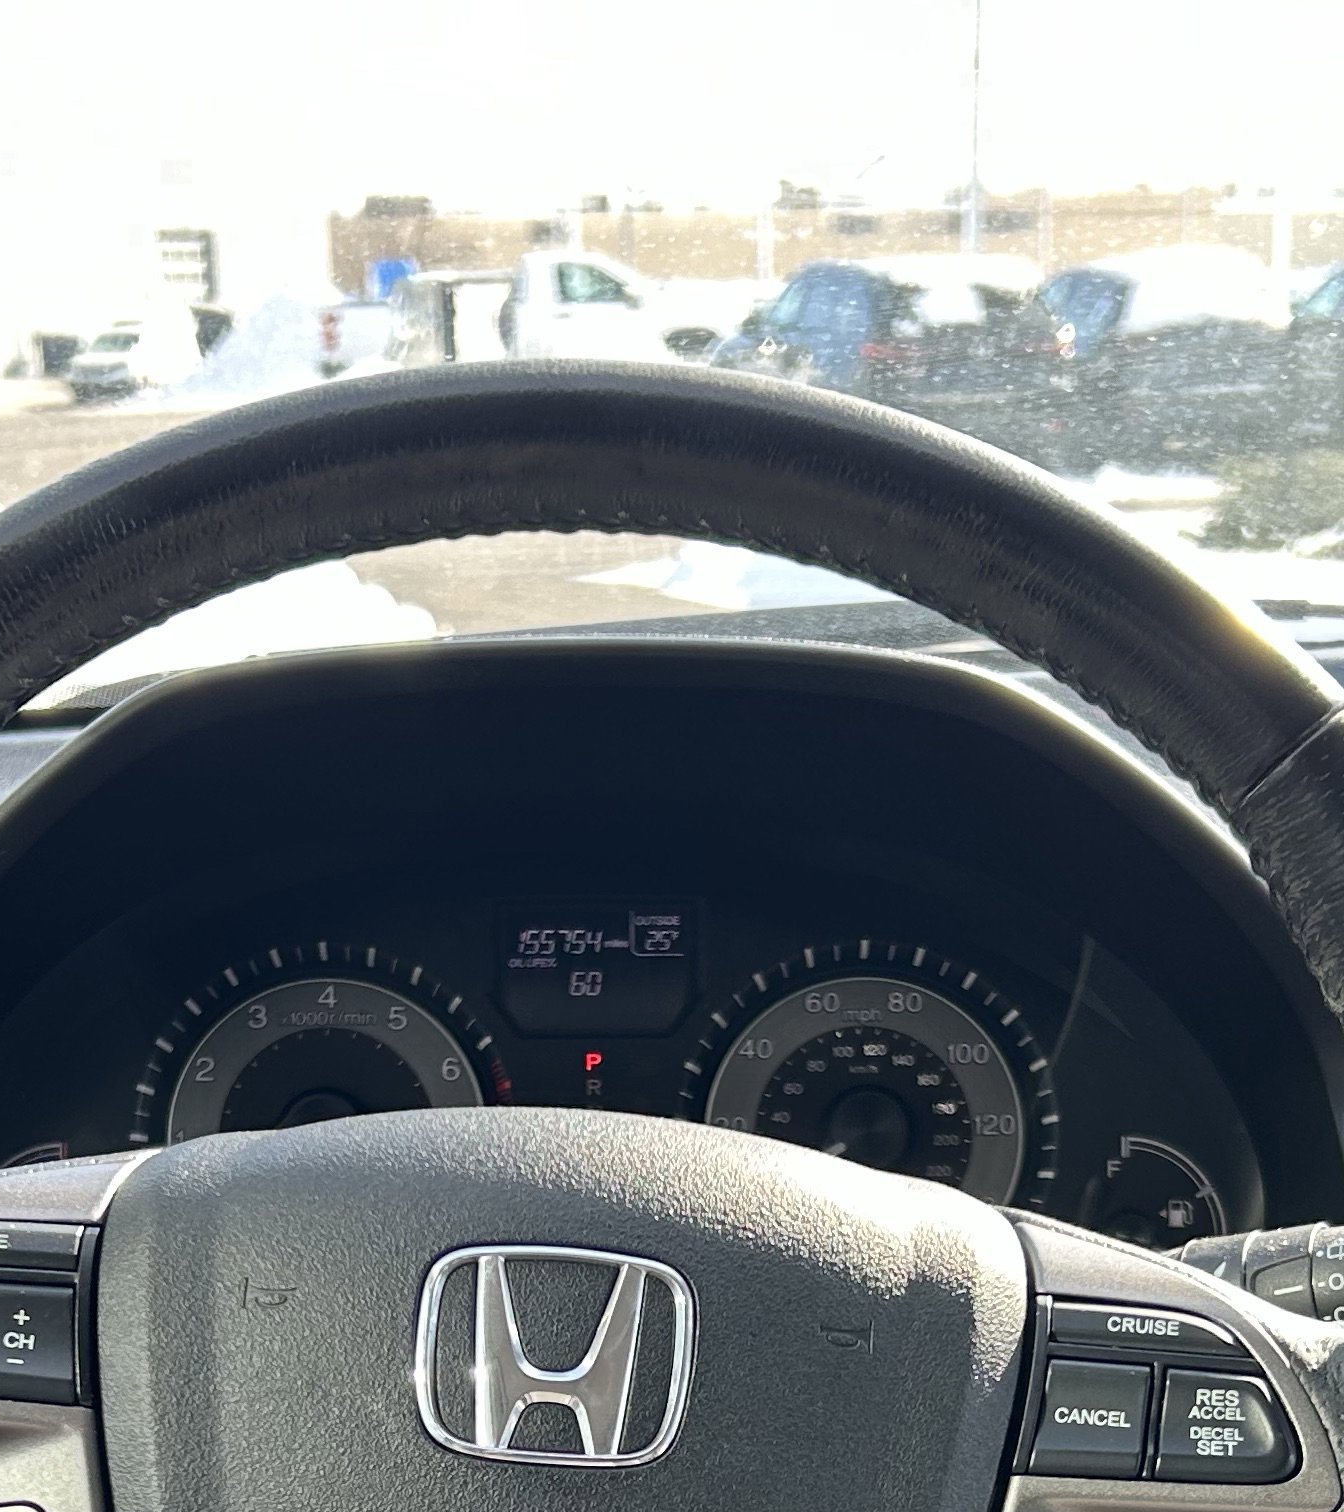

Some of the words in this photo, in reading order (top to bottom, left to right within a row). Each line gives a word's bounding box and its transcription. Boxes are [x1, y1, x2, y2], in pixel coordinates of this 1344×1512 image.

[317, 984, 338, 1009] 4
[805, 992, 840, 1013] 60
[888, 992, 923, 1013] 80
[247, 1005, 268, 1029] 3
[387, 1006, 408, 1031] 5
[738, 1038, 774, 1060] 40
[947, 1043, 990, 1065] 100
[194, 1057, 216, 1082] 2
[441, 1057, 462, 1082] 6
[585, 1051, 603, 1072] P
[585, 1079, 603, 1096] R
[973, 1113, 1017, 1136] 120
[1106, 1160, 1122, 1179] F
[1106, 1316, 1180, 1336] CRUISE
[3, 1331, 35, 1351] CH
[1196, 1388, 1240, 1407] RES
[1054, 1407, 1132, 1429] CANCEL
[1188, 1405, 1246, 1422] ACCEL
[1189, 1426, 1245, 1442] DECEL
[1196, 1440, 1239, 1456] SET
